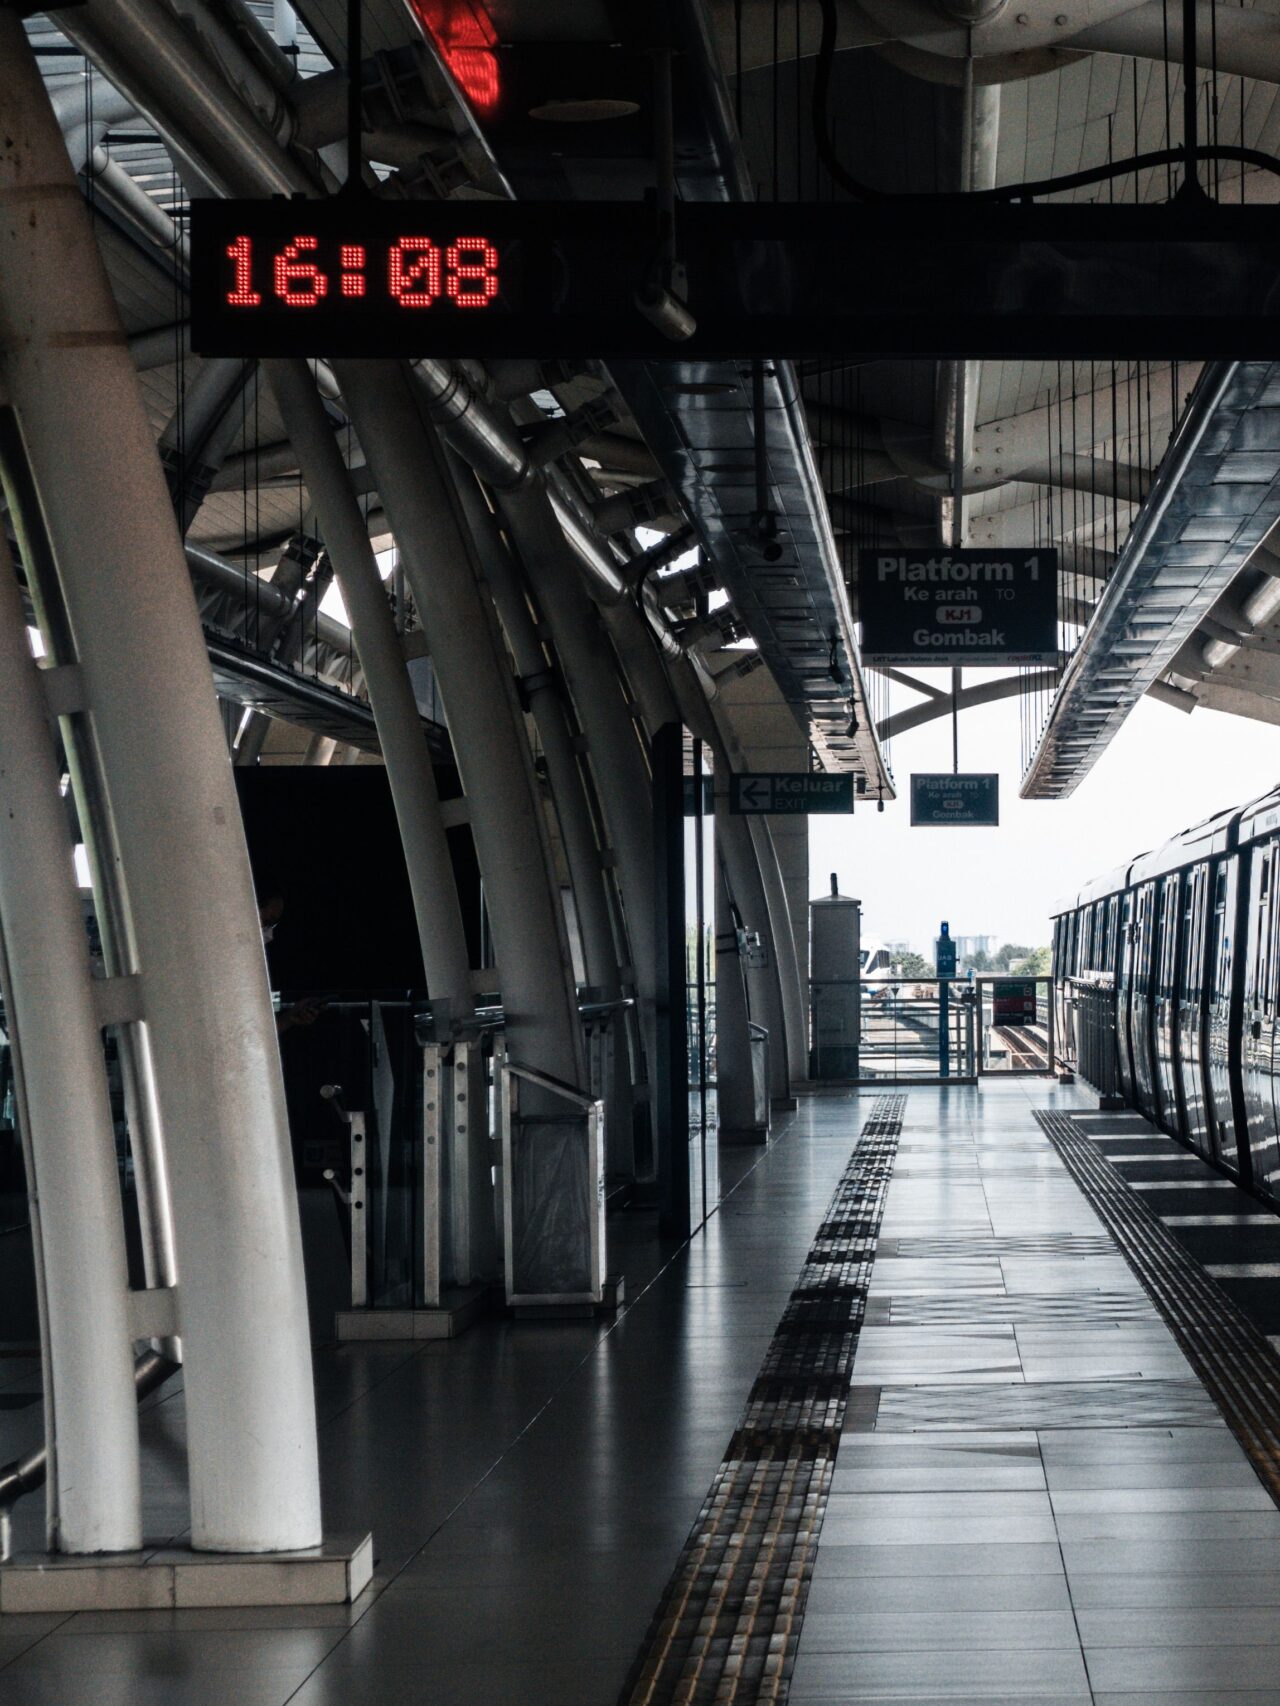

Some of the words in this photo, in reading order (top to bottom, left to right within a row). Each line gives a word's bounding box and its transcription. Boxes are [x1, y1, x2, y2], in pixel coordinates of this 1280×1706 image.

[225, 235, 500, 308] 16:08
[877, 556, 1014, 582] Platform
[1023, 556, 1039, 582] 1
[904, 586, 930, 601] Ke
[935, 586, 978, 601] arah
[996, 588, 1016, 601] TO
[945, 608, 972, 621] KJ1
[913, 628, 1006, 646] Gombak
[775, 777, 843, 793] Keluar
[917, 778, 978, 790] Platform
[982, 778, 991, 790] 1
[775, 798, 807, 810] EXIT
